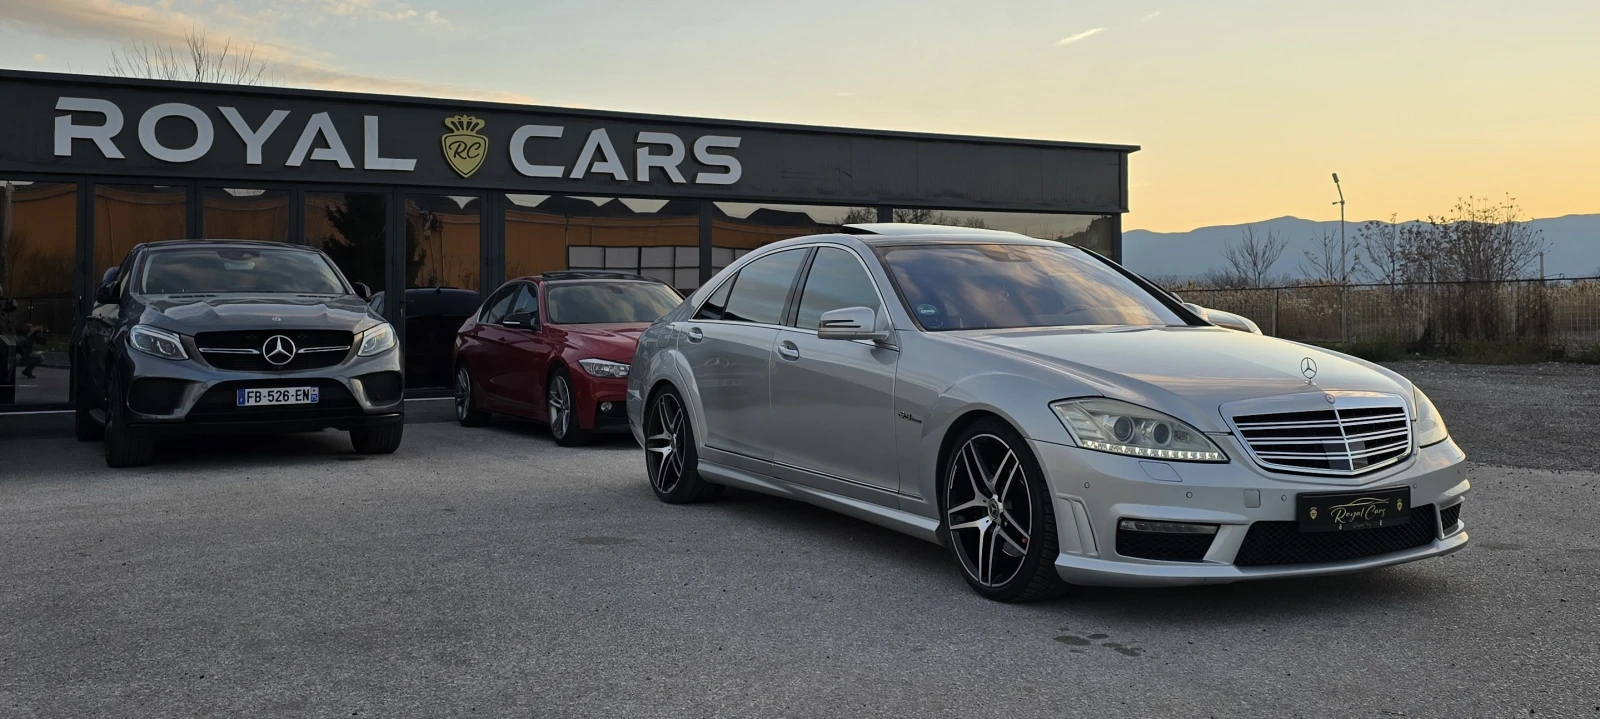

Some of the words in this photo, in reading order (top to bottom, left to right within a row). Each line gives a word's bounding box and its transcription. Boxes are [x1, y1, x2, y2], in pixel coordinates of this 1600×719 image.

[54, 97, 417, 171] ROYAL
[448, 140, 481, 160] RC
[509, 124, 742, 185] CARS
[246, 389, 310, 404] FB-526-EN
[1330, 507, 1365, 523] Royal
[1364, 504, 1386, 520] Cars
